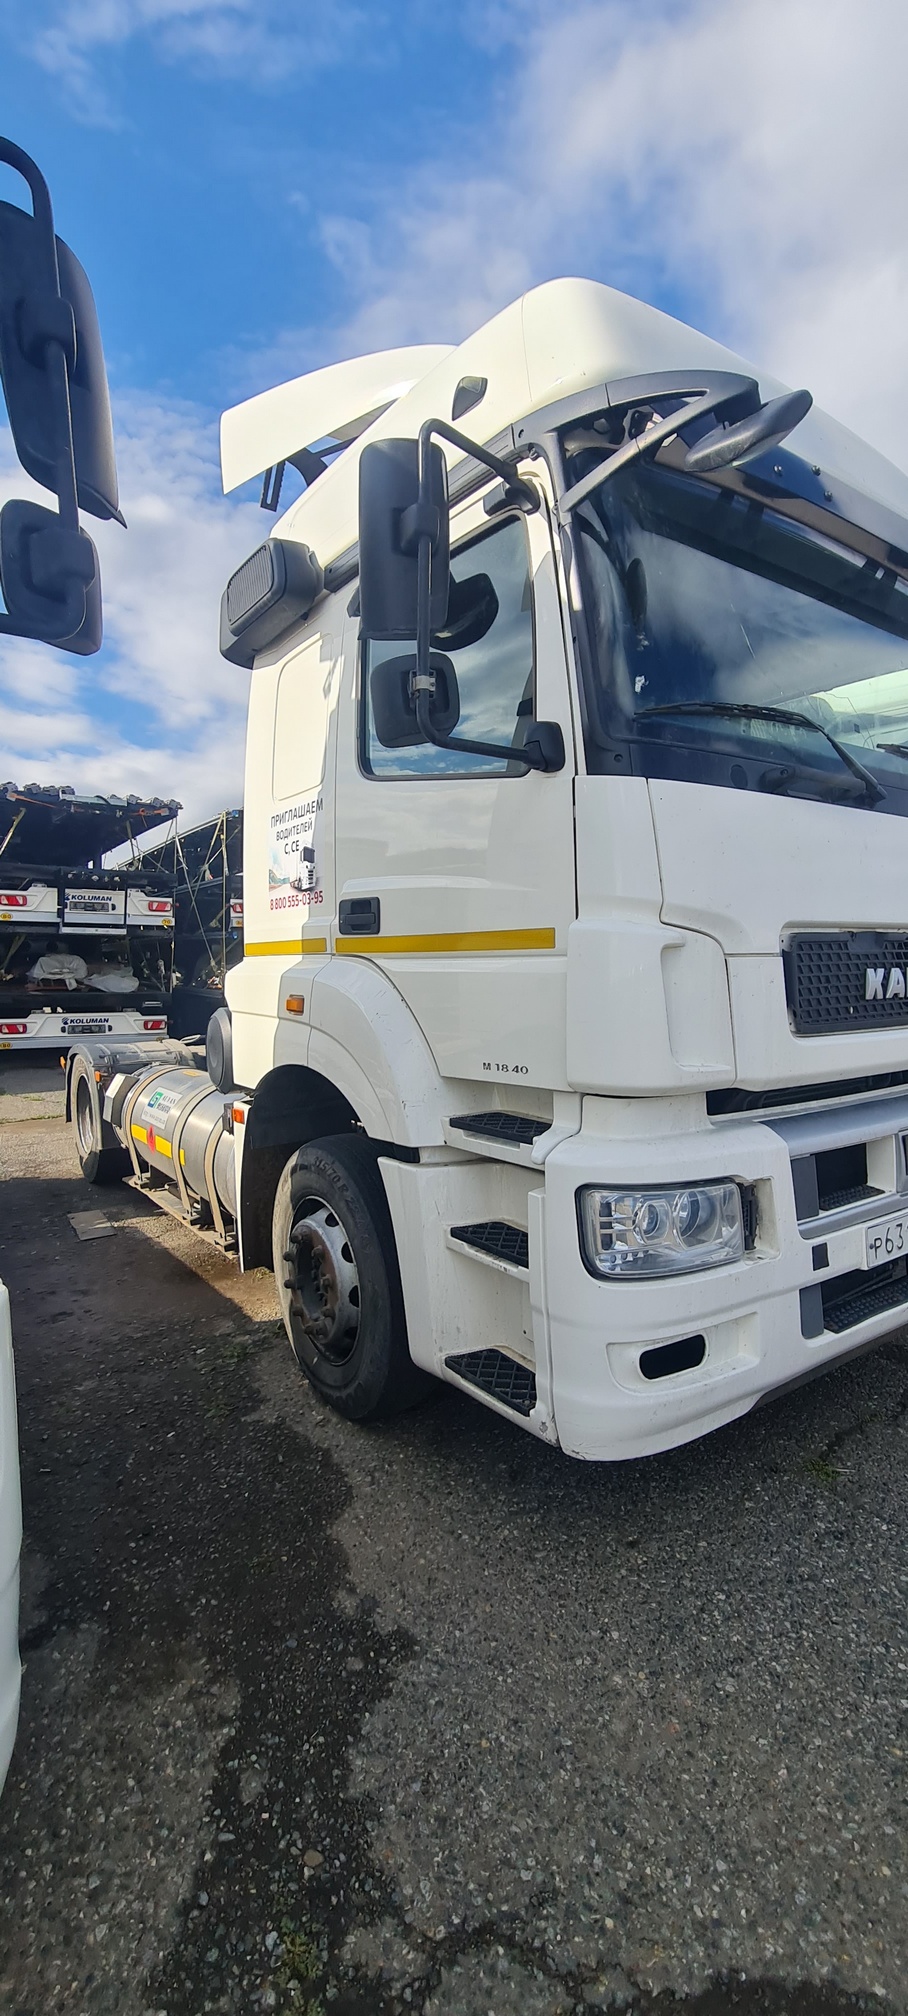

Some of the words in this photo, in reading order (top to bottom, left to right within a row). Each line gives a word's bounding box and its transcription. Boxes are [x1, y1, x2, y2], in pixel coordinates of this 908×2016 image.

[270, 797, 324, 828] ПРИГЛАШАЕМ
[275, 817, 313, 841] ВОДИТЕЛЕЙ
[71, 894, 113, 902] KOLUMAN
[274, 896, 287, 910] 800
[287, 890, 324, 908] 555-03-95
[865, 967, 908, 1000] KA
[873, 1222, 908, 1260] Р63
